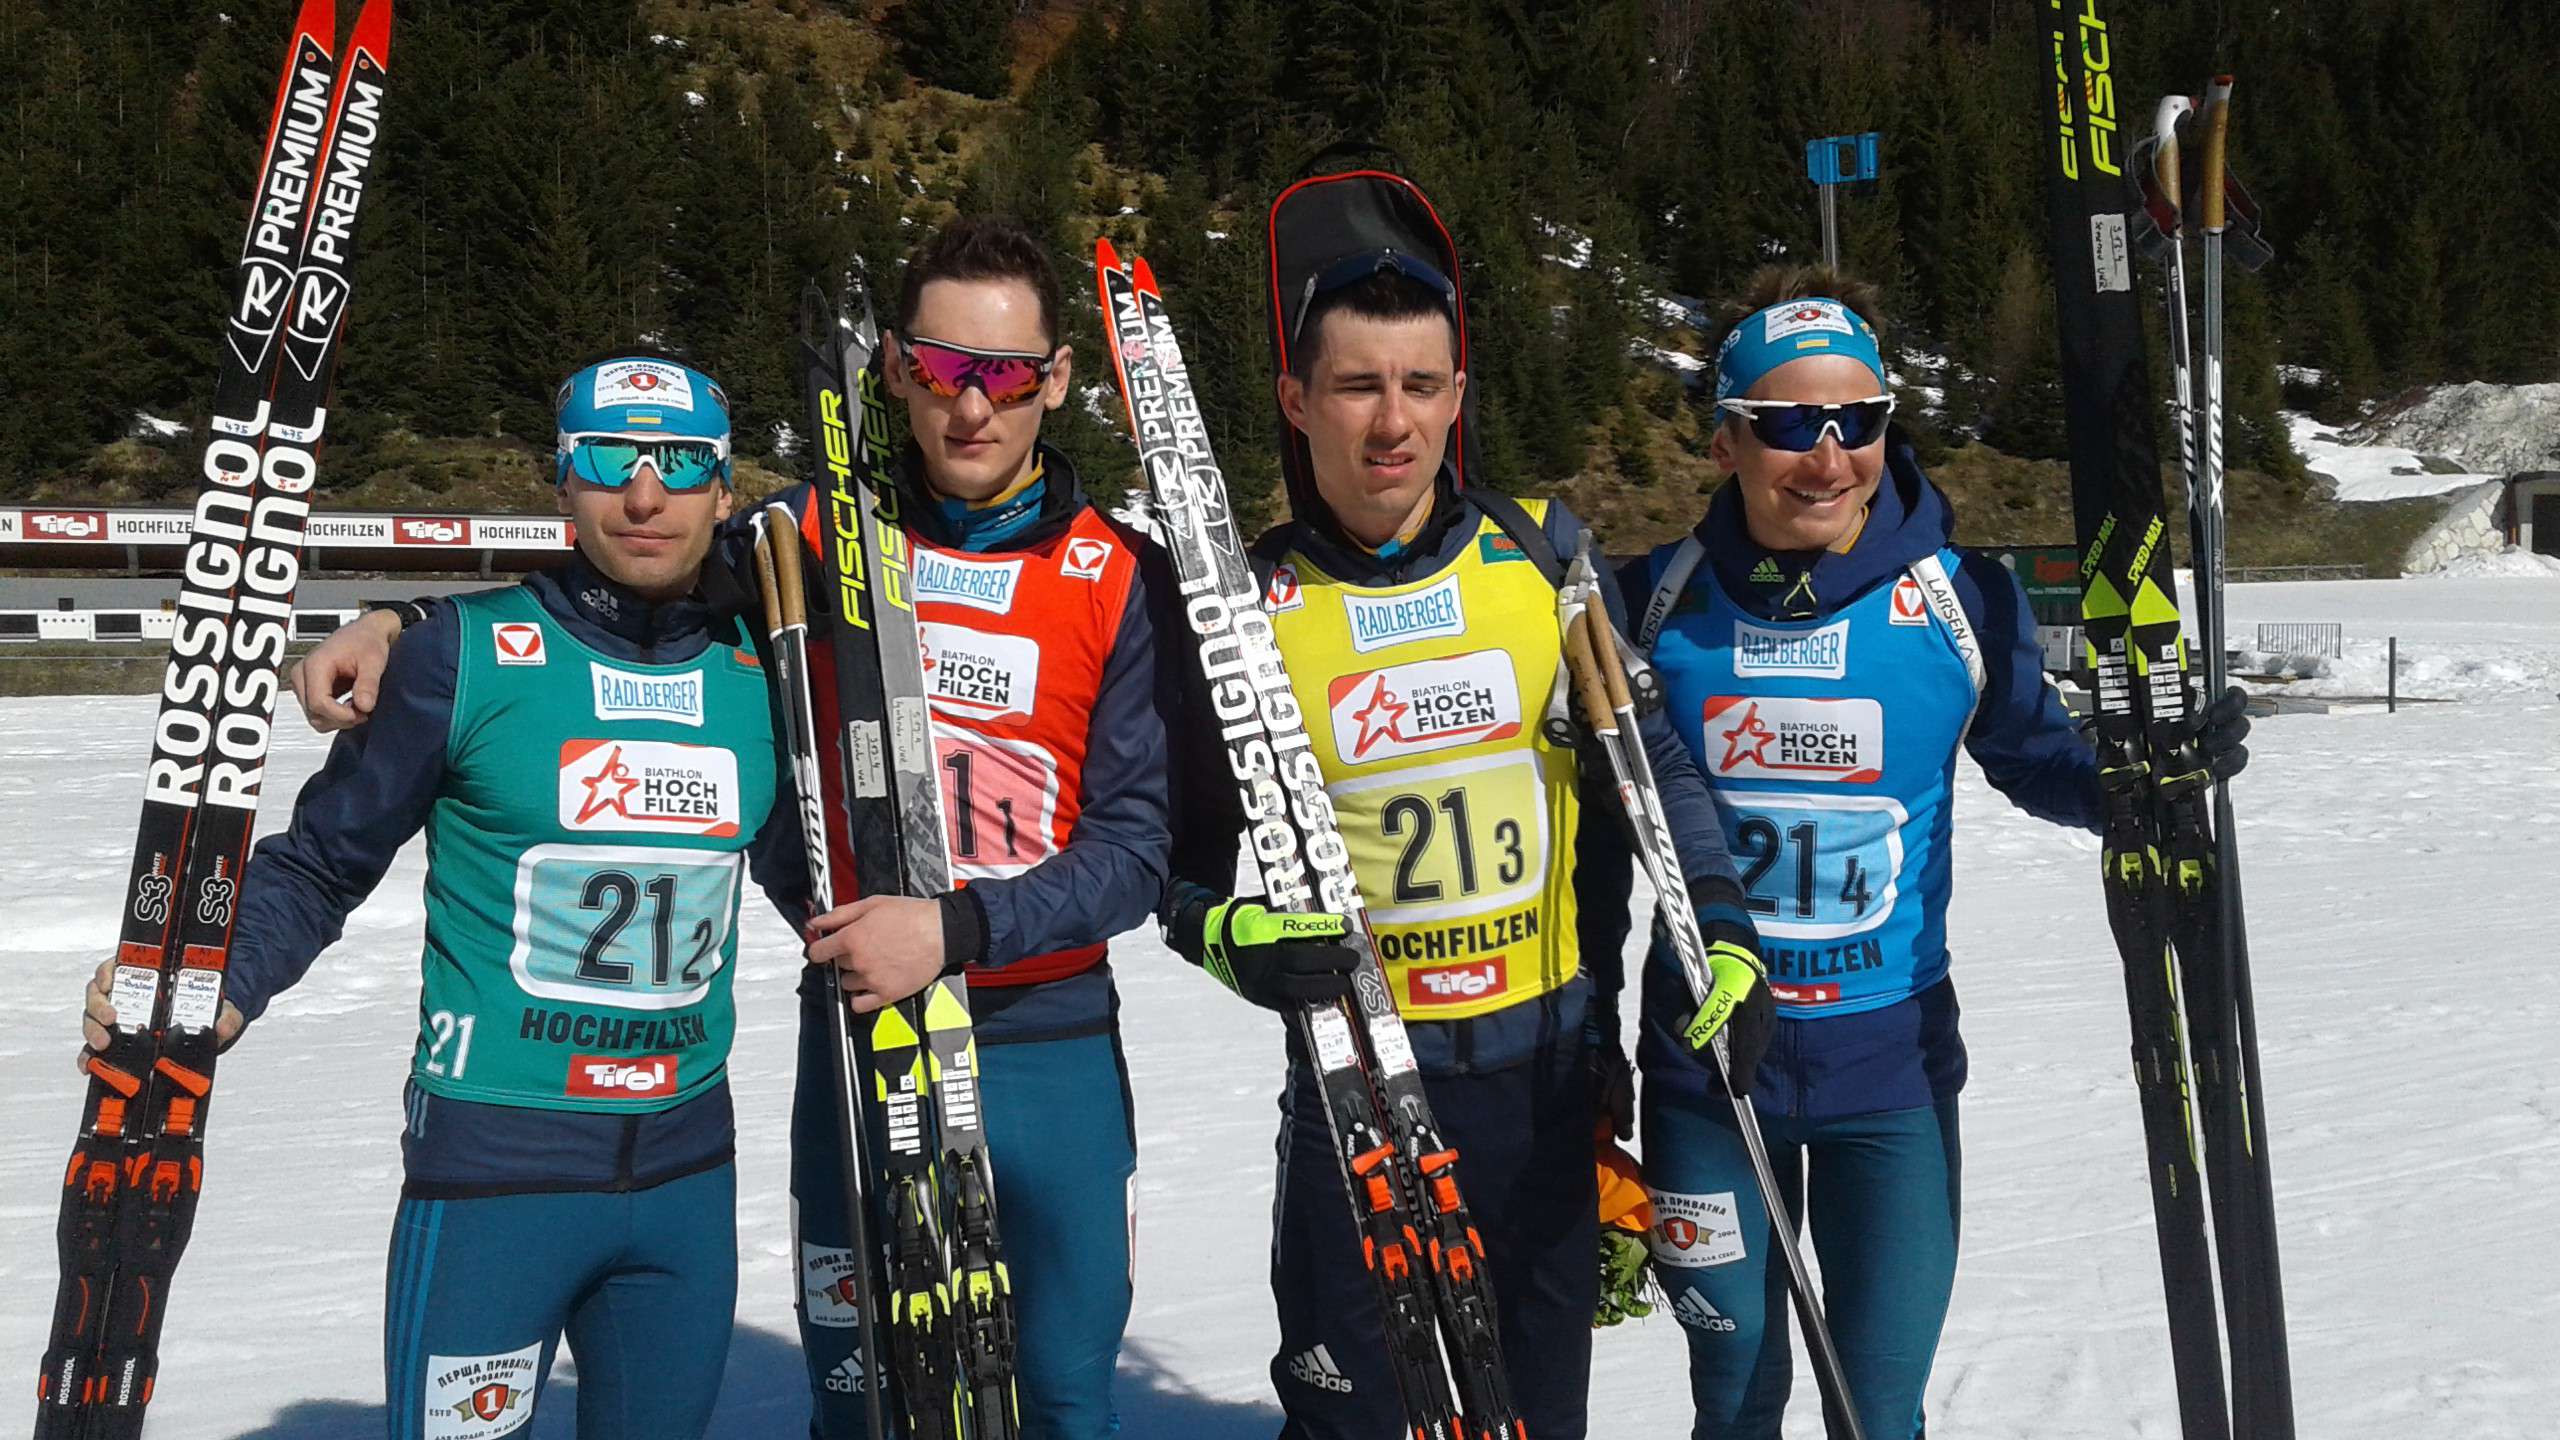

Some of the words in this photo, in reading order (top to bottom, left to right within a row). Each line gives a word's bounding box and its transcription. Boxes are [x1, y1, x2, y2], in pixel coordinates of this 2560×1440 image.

[256, 66, 332, 255] PREMIUM
[310, 79, 384, 264] PREMIUM
[224, 421, 250, 435] 475
[280, 427, 305, 442] 475
[2208, 354, 2224, 518] SWIX
[857, 367, 912, 613] FISCHER
[32, 514, 98, 538] Tirol
[117, 519, 193, 535] HOCHFILZE
[819, 388, 870, 630] FISCHER
[304, 522, 385, 538] HOCHFILZEN
[401, 521, 463, 542] Tirol
[478, 526, 558, 541] HOCHFILZEN
[2127, 545, 2151, 587] SPEED
[2143, 513, 2165, 553] MAX
[917, 554, 1010, 601] RADLBERGER
[144, 399, 272, 808] ROSSIGNOL
[204, 406, 327, 811] ROSSIGNOL
[581, 590, 620, 622] adidas
[1355, 587, 1458, 639] RADLBERGER
[1639, 586, 1673, 653] LARSEN
[1927, 577, 1968, 642] LARSEN
[940, 649, 996, 667] BIATHLON
[1740, 630, 1841, 666] RADLBERGER
[937, 678, 1010, 705] FILZEN
[938, 660, 1012, 688] HOCH
[1412, 680, 1471, 698] BIATHLON
[601, 675, 698, 713] RADLBERGER
[1413, 687, 1493, 716] HOCH
[1180, 545, 1315, 908] ROSSIGNOL
[1416, 706, 1497, 733] FILZEN
[1779, 722, 1839, 733] BIATHLON
[1226, 571, 1365, 917] ROSSIGNOL
[1779, 733, 1858, 750] HOCH
[1780, 749, 1858, 765] FILZEN
[644, 767, 703, 780] BIATHLON
[644, 778, 718, 800] HOCH
[644, 797, 718, 817] FILZEN
[942, 749, 978, 858] 1
[995, 797, 1017, 857] 1
[802, 753, 833, 911] SWIX
[1380, 786, 1479, 905] 21
[1494, 817, 1525, 886] 3
[1640, 783, 1702, 936] SWIX
[1737, 815, 1818, 919] 21
[1839, 854, 1873, 917] 4
[134, 873, 173, 926] S3
[197, 876, 236, 928] S3
[575, 869, 677, 987] 21
[681, 917, 713, 985] 2
[1421, 964, 1497, 996] Tirol
[425, 1009, 476, 1081] 21
[519, 1006, 709, 1051] HOCHFILZEN
[584, 1062, 666, 1091] Tirol
[1671, 1221, 1690, 1243] 1
[1675, 1307, 1737, 1333] adidas
[58, 1356, 76, 1405] ROSSIGNOL
[118, 1356, 137, 1407] ROSSIGNOL
[437, 1363, 482, 1389] ПЕРША
[1288, 1359, 1353, 1394] adidas
[482, 1388, 501, 1414] 1
